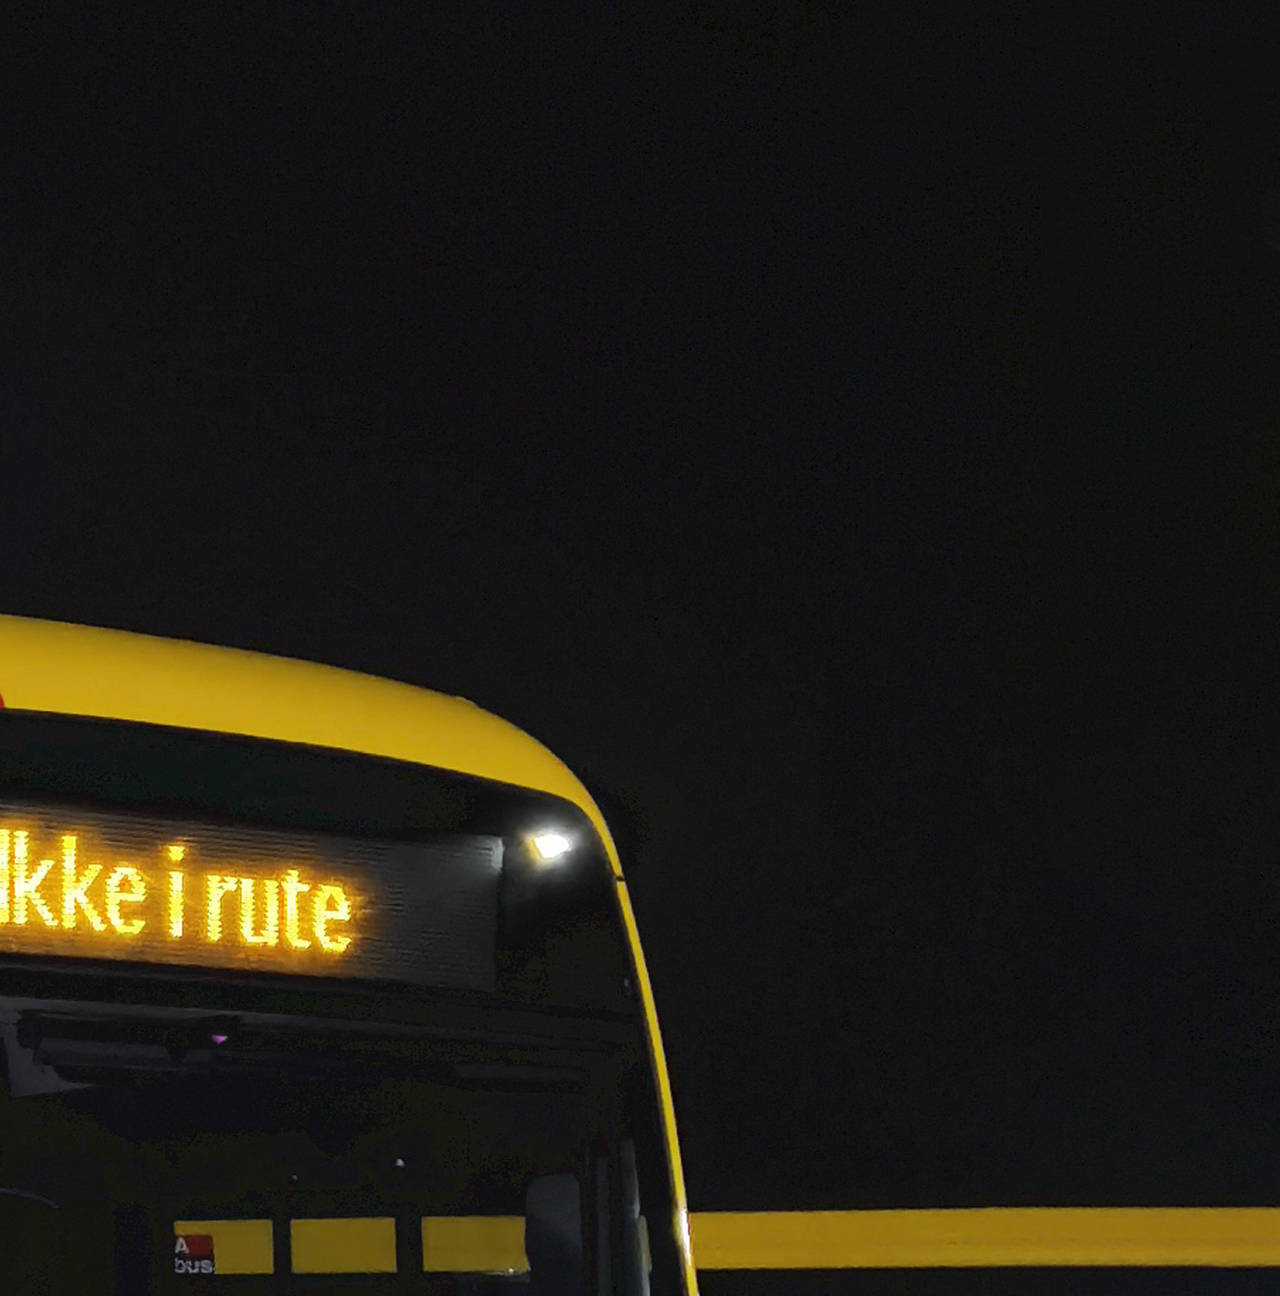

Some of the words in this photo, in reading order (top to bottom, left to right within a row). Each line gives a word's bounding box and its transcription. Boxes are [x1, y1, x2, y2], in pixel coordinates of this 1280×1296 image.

[167, 845, 185, 938] i
[206, 868, 352, 953] rute
[175, 1236, 189, 1254] A
[175, 1258, 213, 1274] bus
